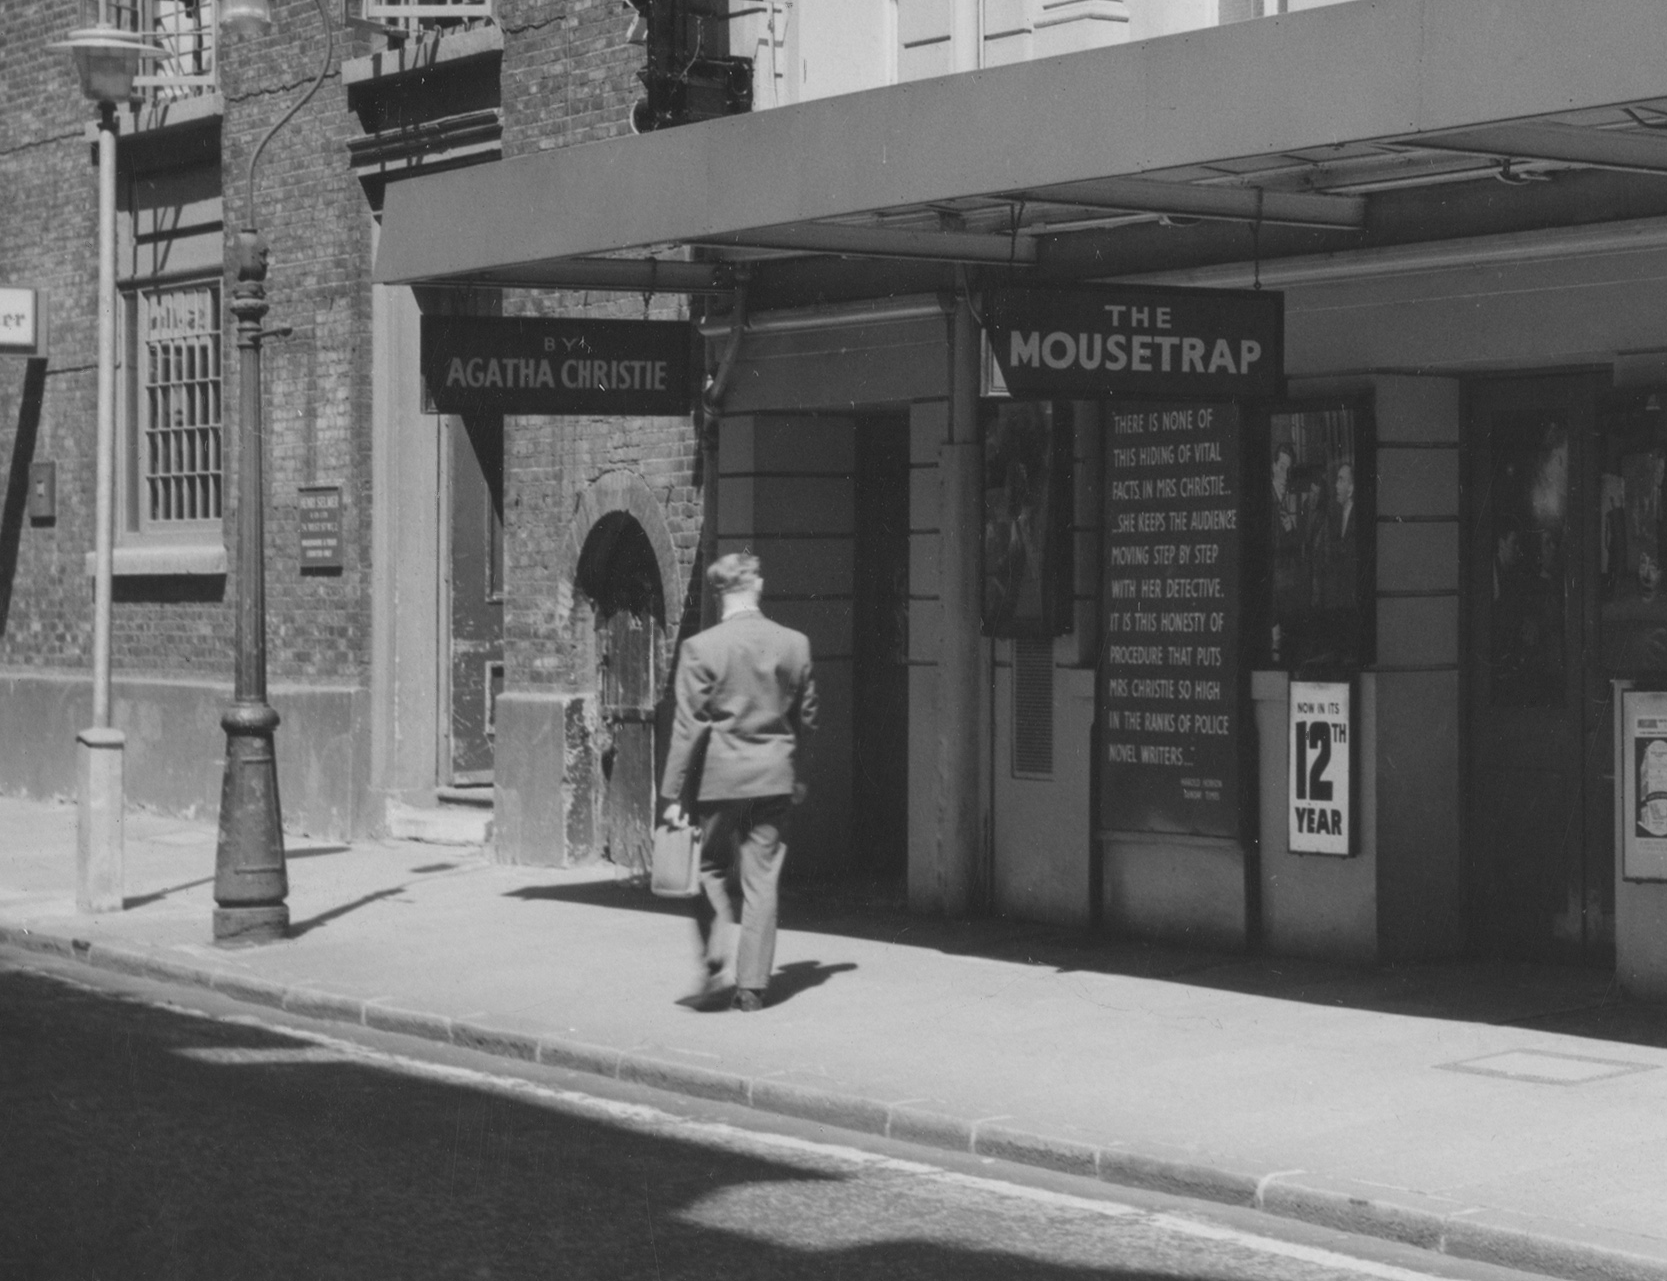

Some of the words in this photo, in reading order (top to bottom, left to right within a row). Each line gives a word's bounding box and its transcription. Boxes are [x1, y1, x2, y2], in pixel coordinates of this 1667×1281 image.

[1104, 304, 1172, 329] THE
[544, 337, 577, 351] BY
[1010, 330, 1262, 374] MOUSETRAP
[446, 357, 555, 389] AGATHA
[561, 358, 668, 390] CHRISTIE
[1162, 409, 1193, 431] NONE
[1113, 447, 1136, 468] THIS
[1139, 444, 1174, 466] HIDING
[1194, 442, 1222, 462] VITAL
[1169, 511, 1187, 531] THE
[1190, 509, 1237, 530] AUDIENCE
[1111, 546, 1148, 566] MOVING
[1154, 545, 1175, 565] STEP
[1194, 544, 1218, 564] STEP
[1111, 579, 1136, 598] WITH
[1141, 579, 1161, 598] HER
[1135, 613, 1156, 631] THIS
[1161, 612, 1206, 632] HONESTY
[1110, 646, 1163, 665] PROCEDURE
[1168, 647, 1191, 665] THAT
[1197, 647, 1221, 667] PUTS
[1131, 679, 1174, 699] CHRISTIE
[1195, 681, 1220, 700] HIGH
[1124, 712, 1141, 731] THE
[1145, 712, 1175, 733] RANKS
[1194, 715, 1229, 734] POLICE
[1109, 744, 1137, 763] NOVEL
[1296, 808, 1341, 834] YEAR
